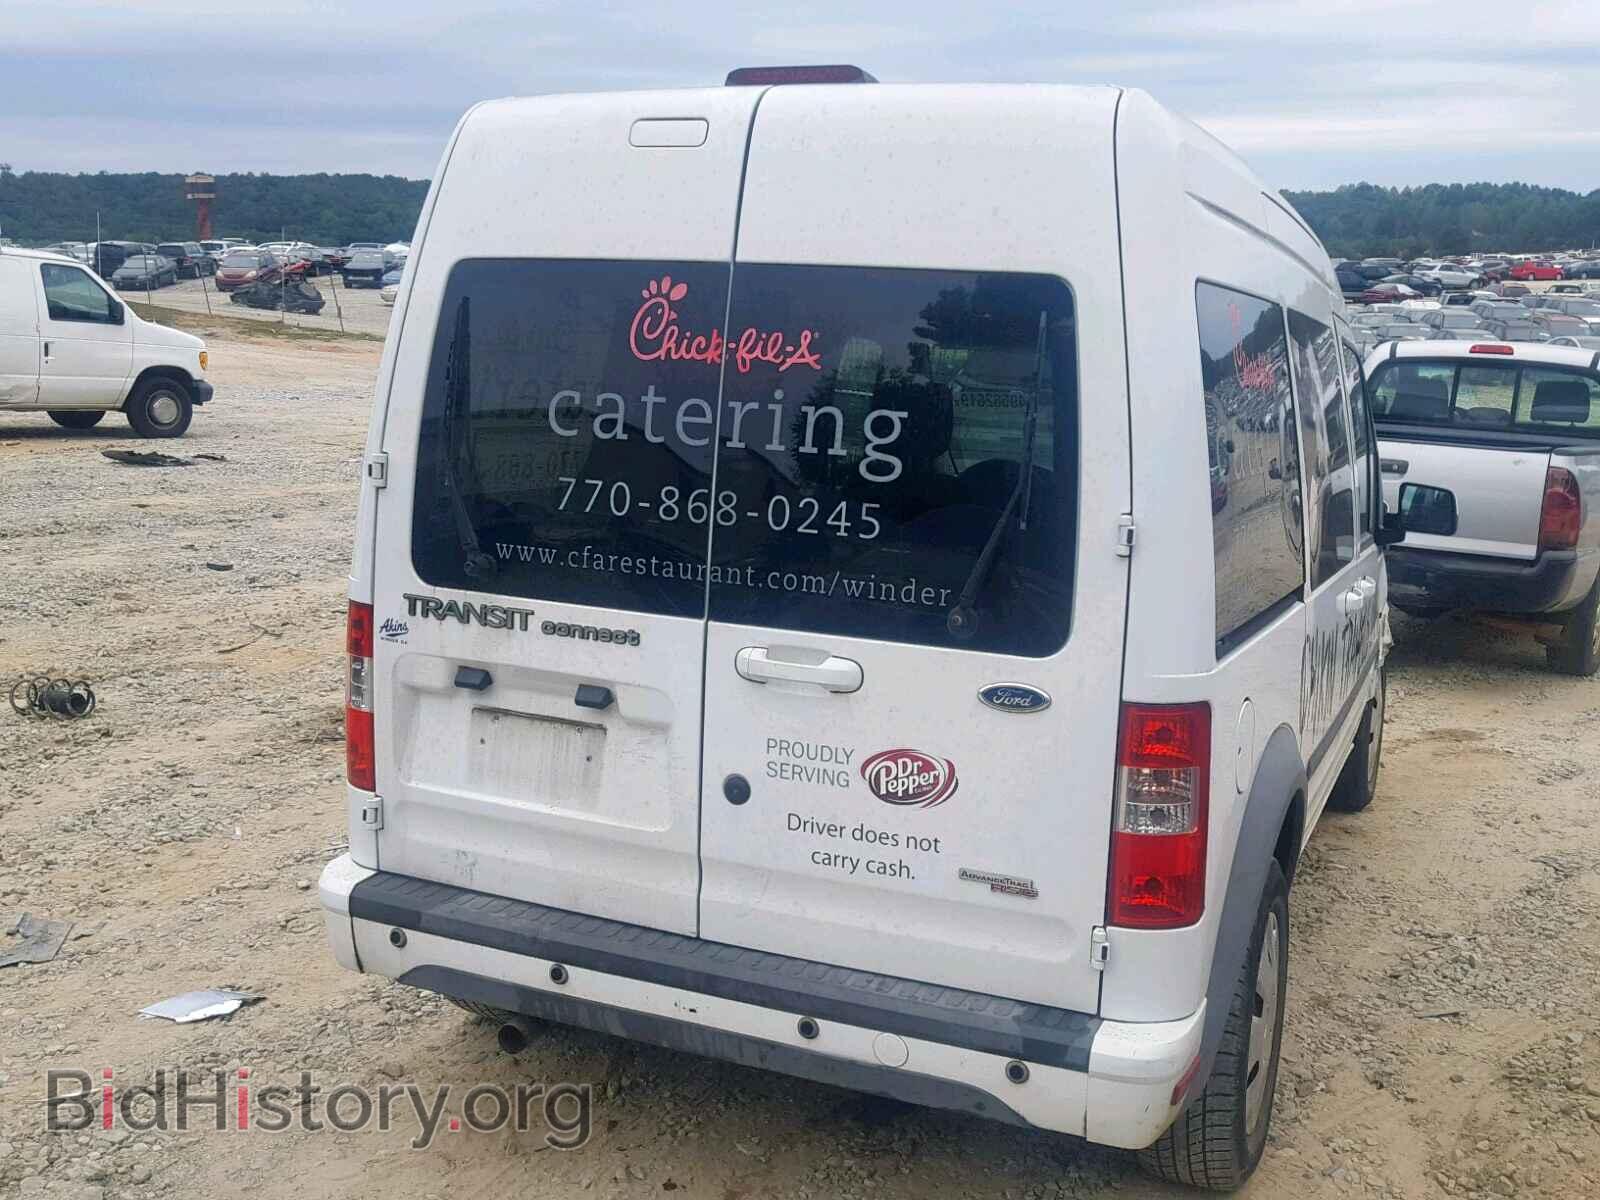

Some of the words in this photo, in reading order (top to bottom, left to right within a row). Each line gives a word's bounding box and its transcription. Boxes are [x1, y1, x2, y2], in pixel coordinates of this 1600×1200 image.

[629, 296, 820, 371] Chick-fil-A
[548, 385, 909, 484] catering
[557, 476, 881, 541] 770-868-0245
[495, 540, 952, 607] www.cfarestaurant.com/winder
[379, 617, 409, 633] Akins
[403, 593, 534, 631] TRANSIT
[541, 619, 640, 647] connect
[992, 688, 1032, 707] Ford
[766, 738, 855, 765] PROUDLY
[897, 757, 922, 777] Dr
[766, 762, 850, 788] SERVING
[879, 761, 940, 797] Pepper
[787, 813, 846, 840] Driver
[852, 823, 899, 848] does
[906, 835, 941, 854] not
[811, 850, 860, 875] carry
[866, 859, 916, 881] cash.
